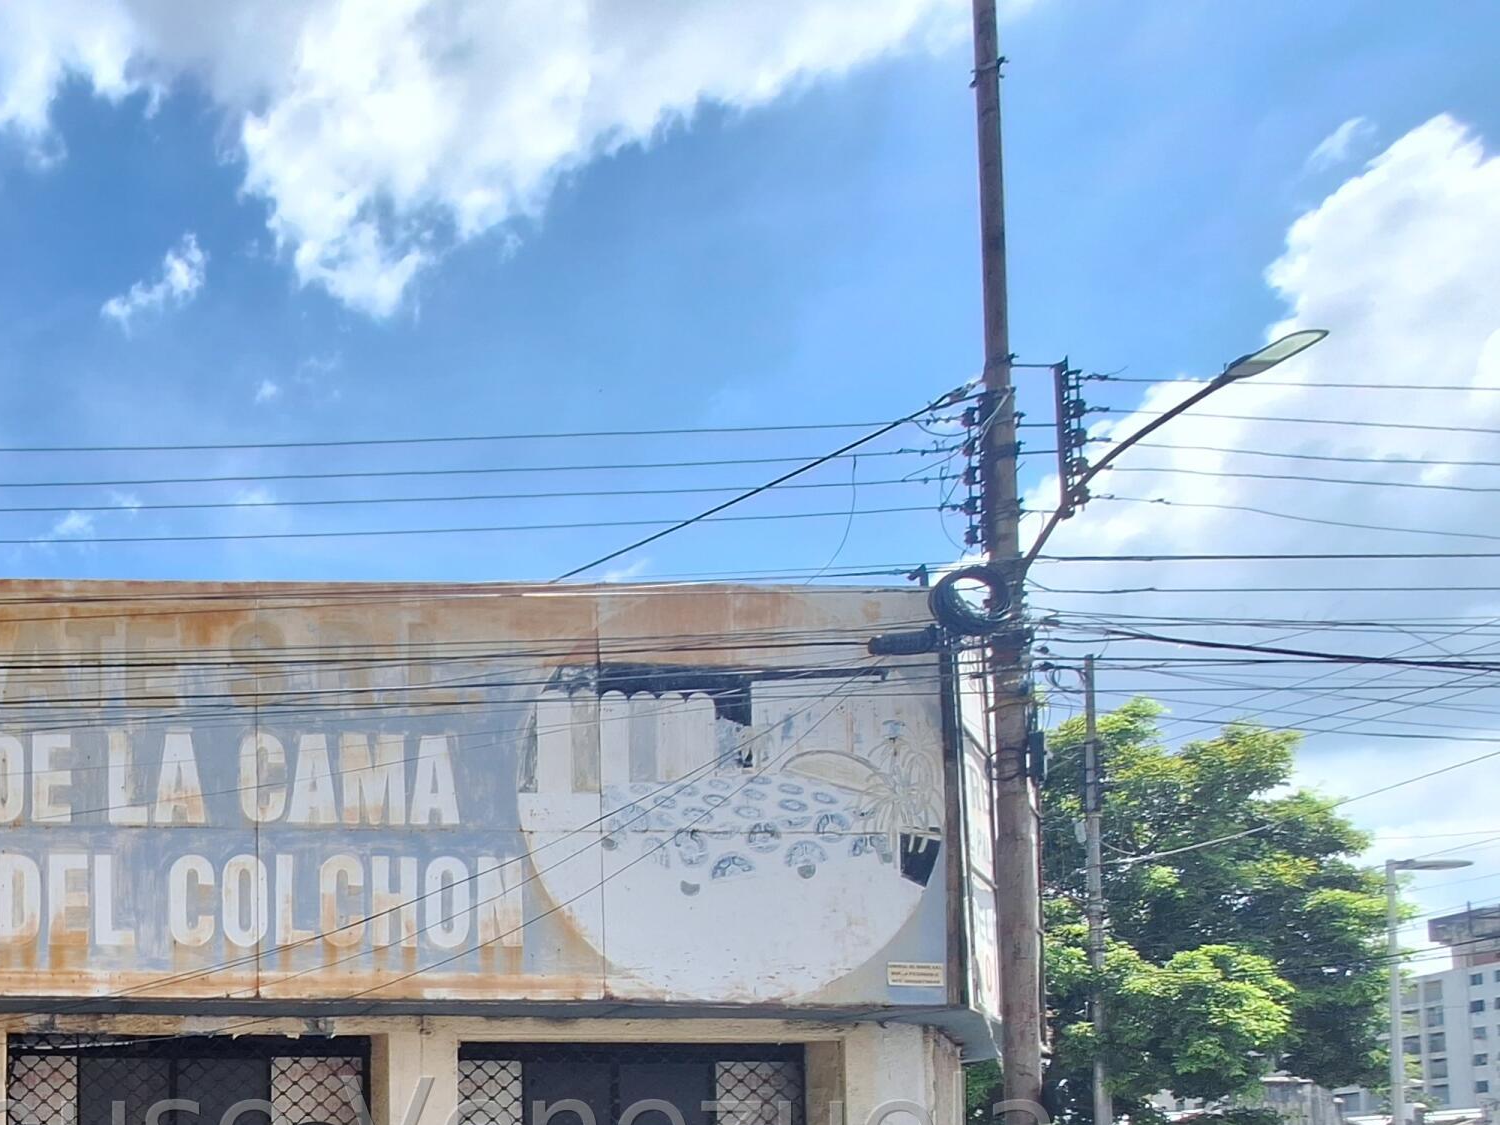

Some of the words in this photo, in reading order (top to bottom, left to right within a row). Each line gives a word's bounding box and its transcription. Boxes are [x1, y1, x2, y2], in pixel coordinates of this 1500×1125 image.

[108, 731, 206, 825] LA
[239, 731, 460, 826] CAMA
[168, 853, 524, 948] COLCHON
